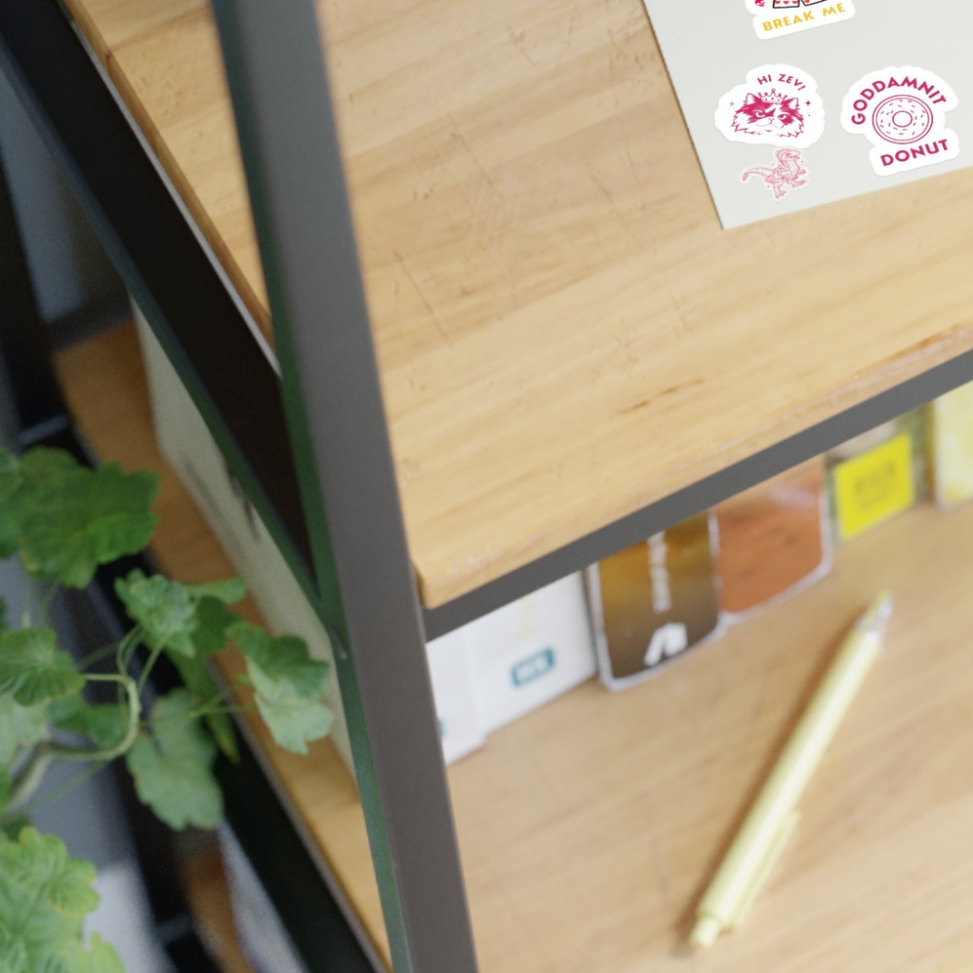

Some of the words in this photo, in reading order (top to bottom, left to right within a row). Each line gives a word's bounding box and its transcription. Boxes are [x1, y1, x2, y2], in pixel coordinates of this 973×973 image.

[762, 10, 815, 31] BREAK
[822, 3, 845, 17] ME
[757, 74, 772, 85] HI
[778, 73, 806, 91] ZEV!
[851, 76, 947, 125] GODDAMNIT
[880, 139, 948, 166] DONUT
